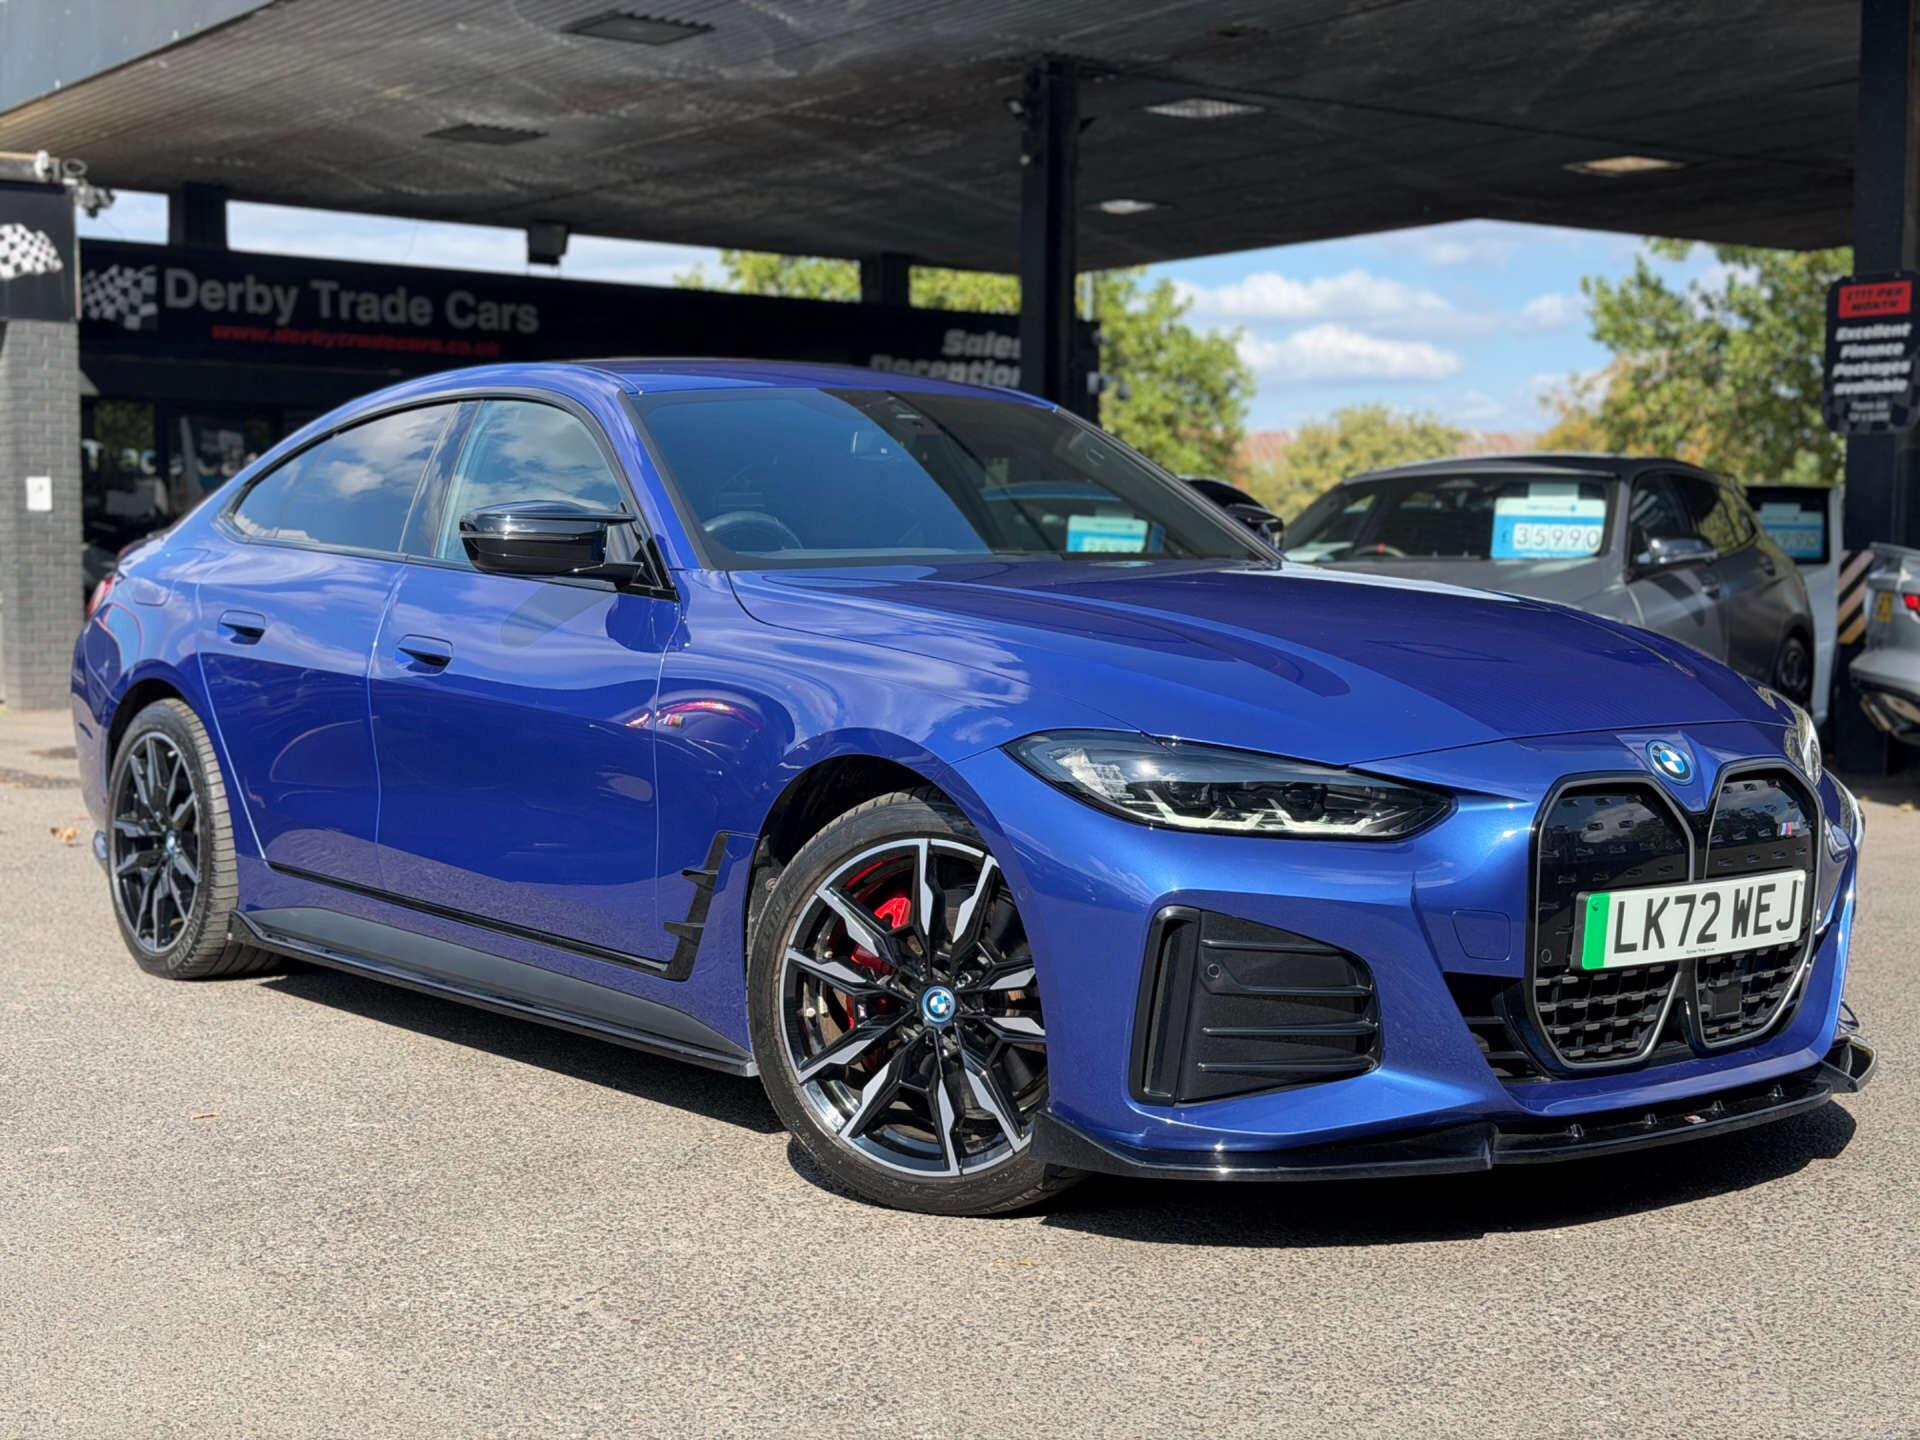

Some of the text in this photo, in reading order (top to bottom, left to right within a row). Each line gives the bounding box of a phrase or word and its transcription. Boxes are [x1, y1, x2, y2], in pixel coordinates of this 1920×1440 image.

[164, 268, 540, 333] Derby Trade Cars
[1835, 322, 1912, 342] Excellent
[1839, 342, 1905, 359] Finance
[1515, 526, 1600, 548] 35990
[1613, 879, 1798, 954] LK72 WEJ
